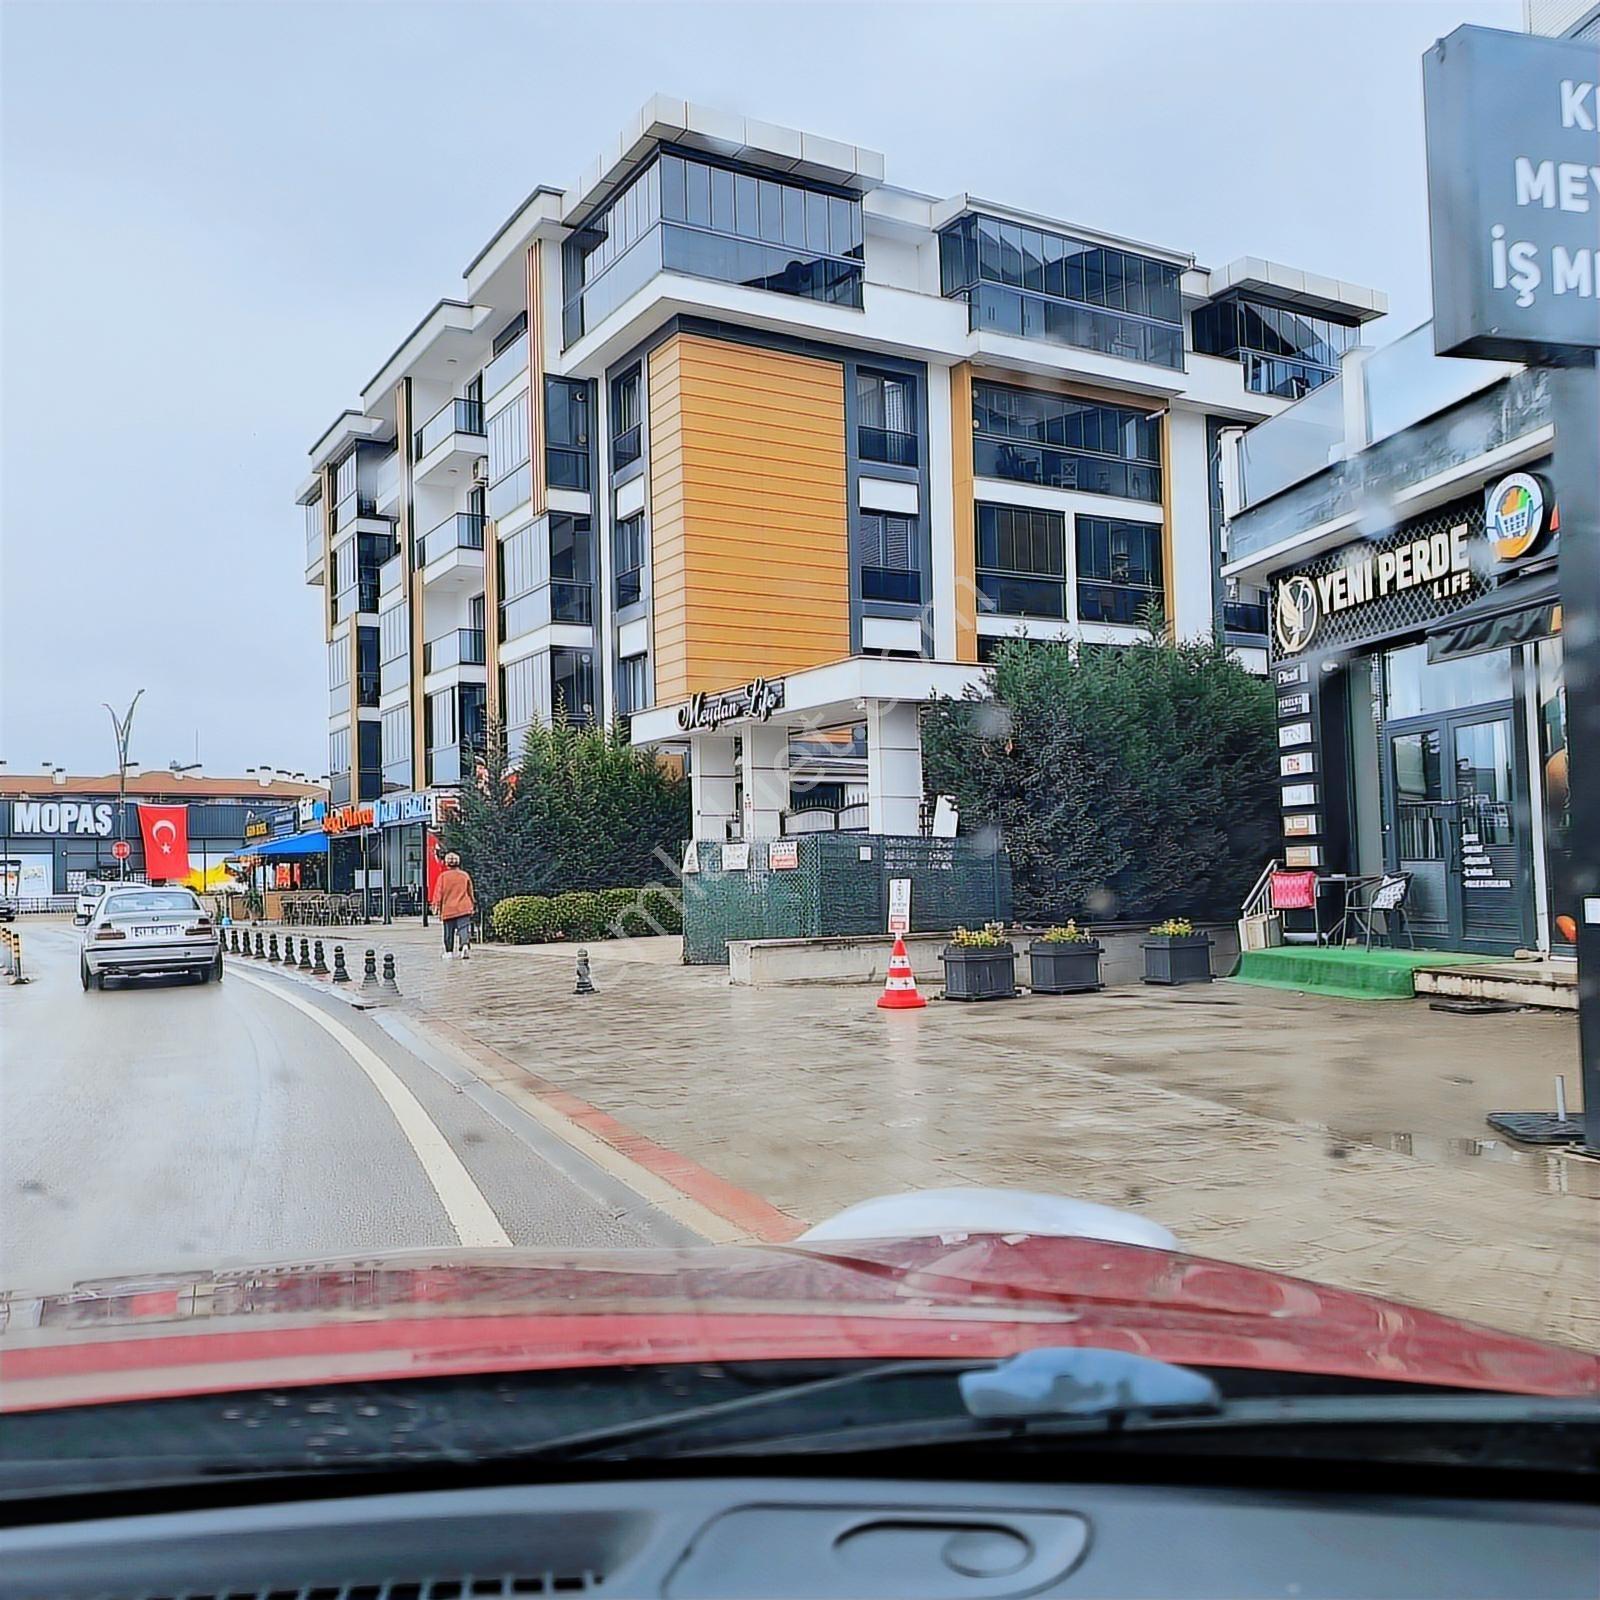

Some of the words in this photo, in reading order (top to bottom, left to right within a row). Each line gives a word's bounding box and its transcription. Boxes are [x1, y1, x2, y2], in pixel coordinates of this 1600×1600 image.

[1560, 79, 1600, 132] K
[1491, 223, 1541, 308] İŞ
[1552, 246, 1600, 299] M
[1378, 523, 1470, 596] PERDE
[1433, 571, 1471, 600] LIFE
[677, 690, 740, 732] Meydan
[742, 675, 778, 722] Life
[13, 802, 113, 837] MOPAŞ
